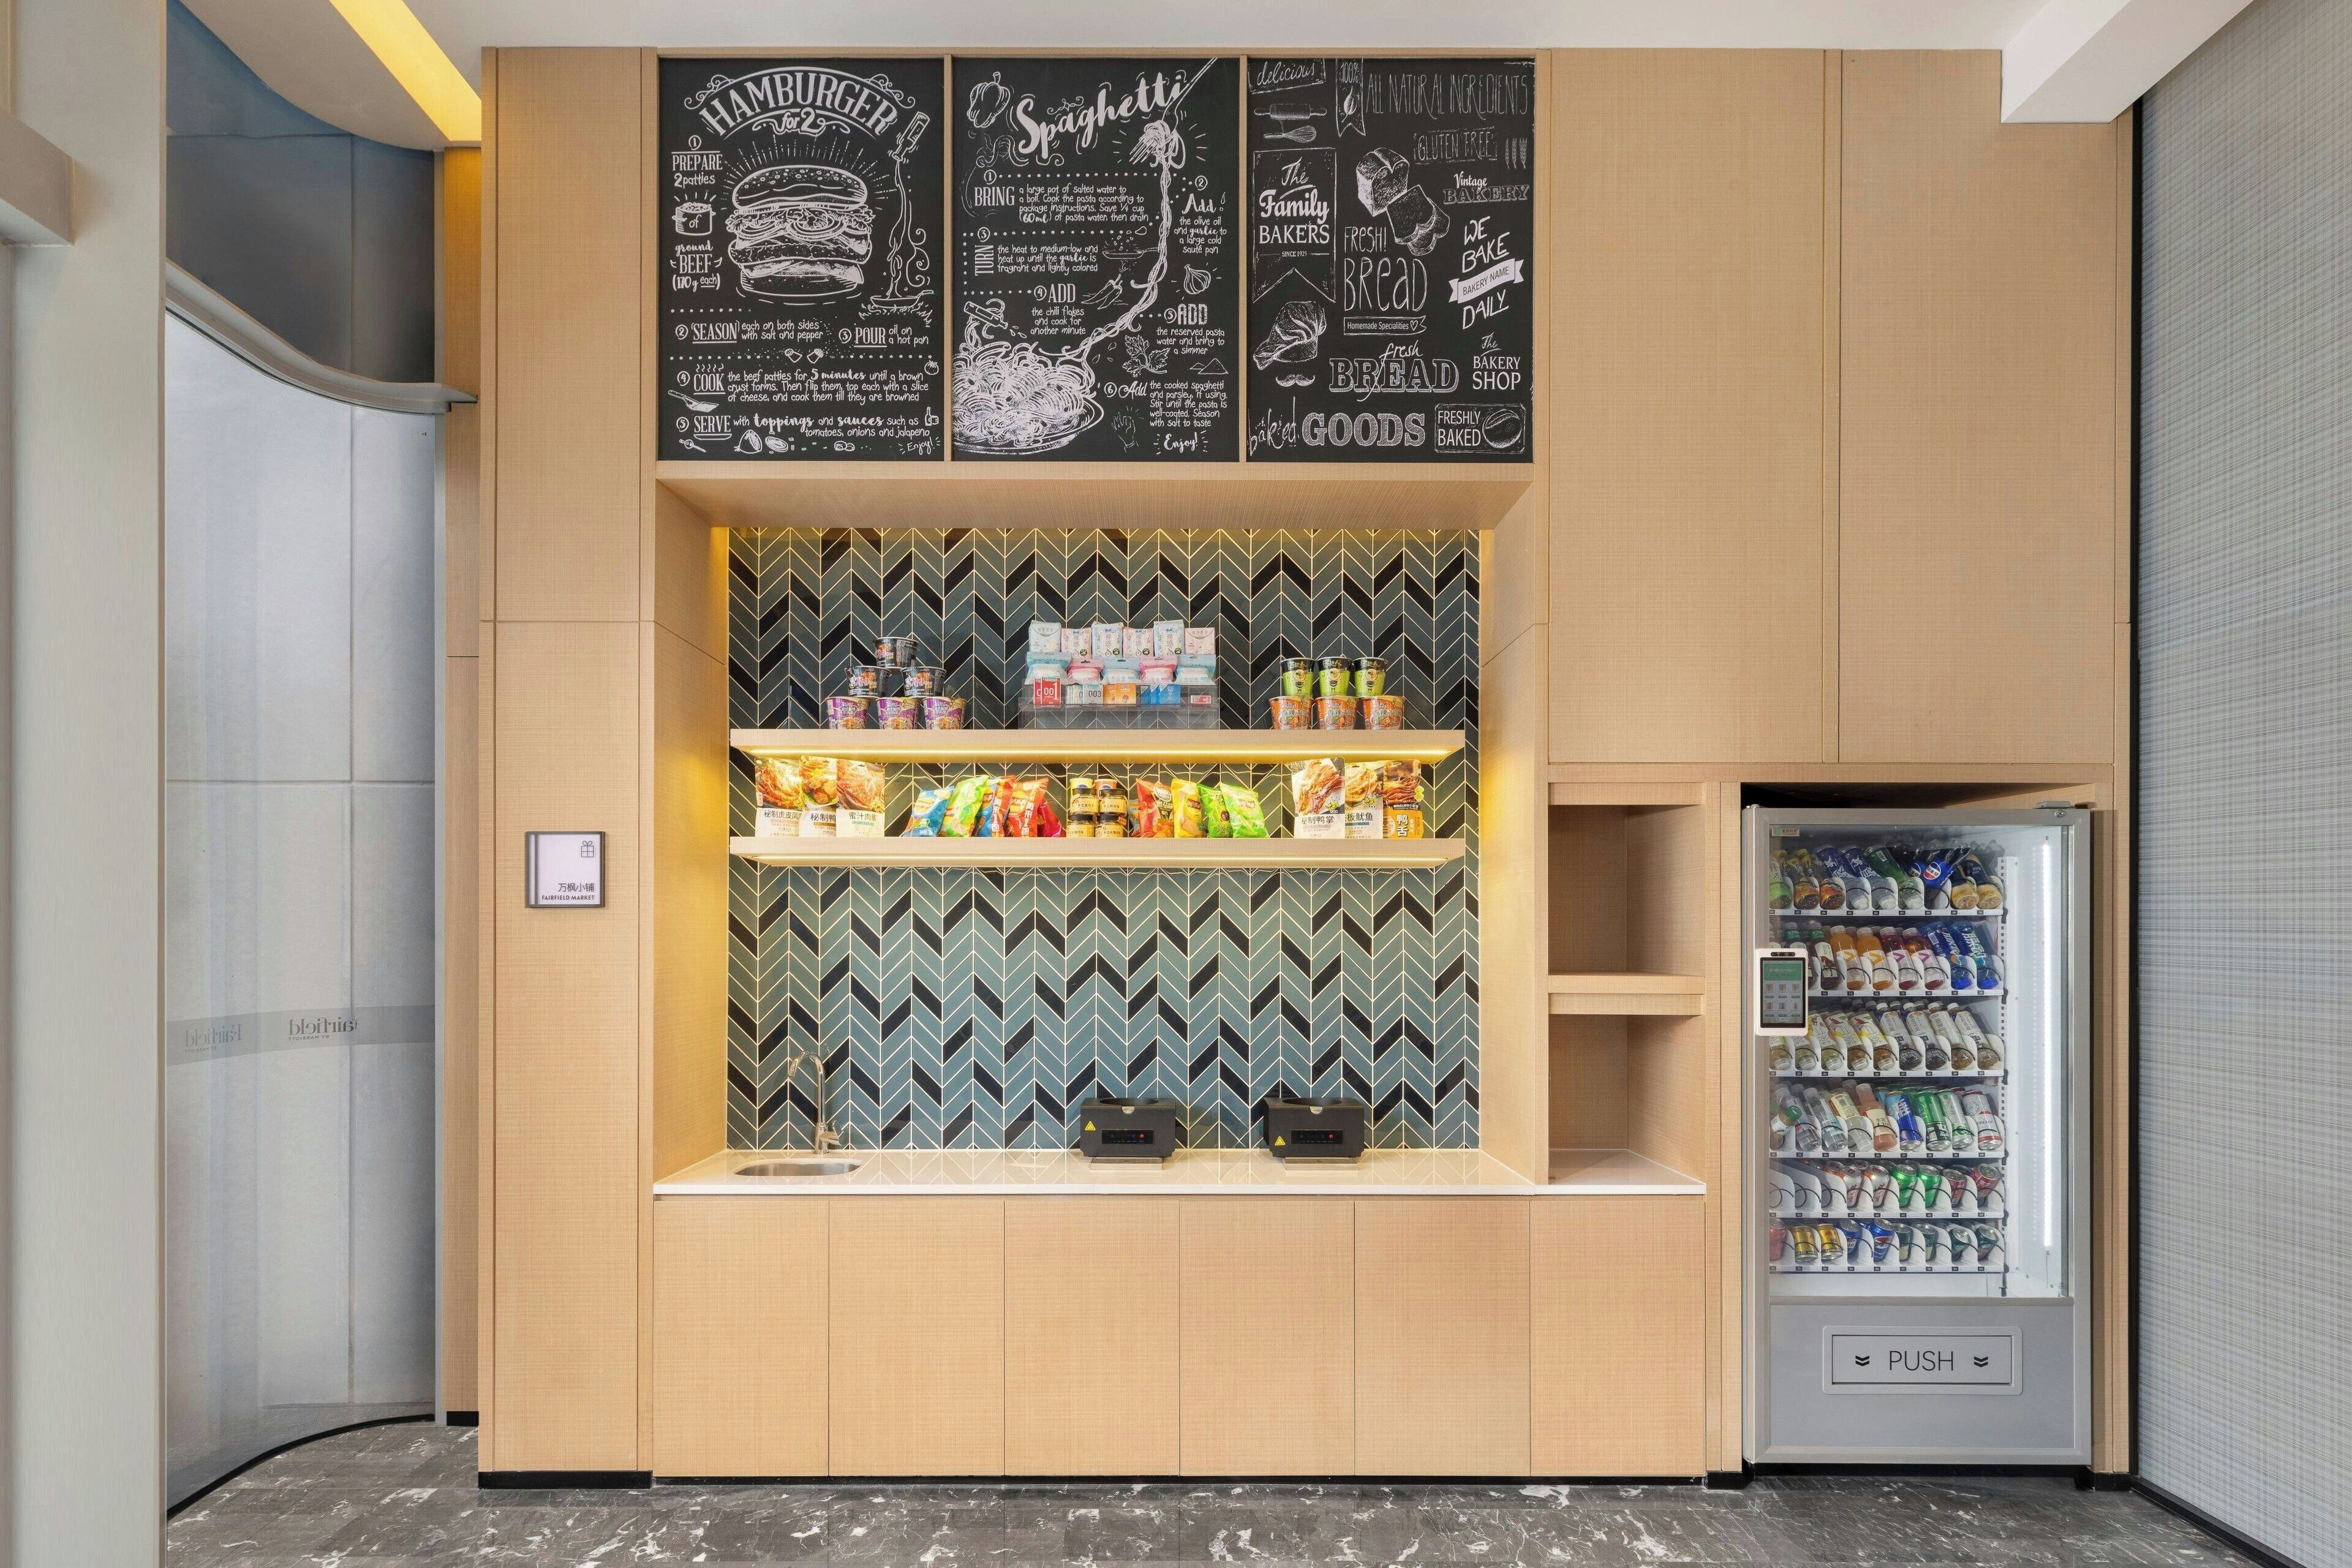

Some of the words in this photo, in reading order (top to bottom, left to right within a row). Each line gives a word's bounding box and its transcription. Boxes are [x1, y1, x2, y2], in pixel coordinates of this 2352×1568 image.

[1257, 61, 1314, 85] delicious
[1341, 62, 1358, 83] 100%
[699, 72, 897, 136] HAMBURGER
[1366, 74, 1384, 114] ALL
[1389, 74, 1444, 119] NATURAL
[1450, 74, 1528, 120] INGREDIENTS
[782, 113, 799, 129] for
[801, 108, 824, 131] 2
[1016, 72, 1182, 159] Spaghetti
[1418, 134, 1458, 160] GLUTEN
[1463, 131, 1492, 159] FREE
[673, 154, 723, 171] PREPARE
[1281, 157, 1309, 186] The
[674, 173, 682, 187] 2
[683, 174, 715, 189] patties
[1453, 171, 1487, 189] Vintage
[974, 186, 1015, 206] BRING
[1027, 184, 1046, 197] large
[1048, 185, 1059, 197] pot
[1062, 183, 1071, 193] of
[1073, 183, 1093, 193] salted
[1443, 184, 1530, 205] BAKERY
[1182, 193, 1216, 214] Add
[1259, 189, 1329, 225] Family
[689, 214, 701, 228] of
[1180, 216, 1191, 225] the
[1194, 216, 1210, 225] olive
[1187, 233, 1205, 246] large
[1208, 235, 1221, 244] cold
[1189, 225, 1218, 239] garlic
[1259, 225, 1330, 244] BAKERS
[1464, 216, 1490, 245] WE
[676, 240, 713, 258] ground
[997, 244, 1009, 255] the
[1012, 244, 1027, 253] heat
[1041, 243, 1082, 252] medium-low
[1205, 247, 1218, 256] pan
[1462, 232, 1510, 273] BAKE
[679, 253, 712, 273] BEEF
[974, 245, 994, 276] TURN
[673, 274, 692, 291] (170
[692, 279, 698, 292] g
[700, 273, 720, 290] each)
[1463, 277, 1488, 296] BAKERY
[1489, 266, 1510, 283] NAME
[1048, 284, 1076, 303] ADD
[1031, 307, 1042, 316] the
[1046, 306, 1060, 315] chili
[1062, 306, 1084, 317] flakes
[1178, 304, 1207, 325] ADD
[1463, 289, 1509, 330] DAILY
[742, 320, 760, 330] each
[777, 320, 794, 330] both
[797, 320, 819, 330] sides
[1051, 314, 1067, 325] cook
[1069, 313, 1083, 325] for
[1379, 322, 1409, 330] Specialities
[693, 323, 737, 340] SEASON
[742, 331, 758, 340] with
[761, 331, 776, 339] salt
[779, 331, 794, 339] and
[797, 331, 823, 342] pepper
[854, 328, 886, 344] POUR
[889, 324, 899, 336] oil
[1030, 326, 1058, 335] another
[1061, 325, 1085, 334] minute
[1156, 326, 1168, 335] the
[1205, 328, 1224, 340] pasta
[896, 333, 910, 344] hot
[914, 336, 929, 347] pan
[1481, 332, 1498, 349] The
[1357, 340, 1423, 402] fresh
[1473, 356, 1521, 369] BAKERY
[694, 374, 725, 391] COOK
[728, 371, 741, 381] the
[744, 369, 763, 382] beef
[764, 371, 791, 385] patties
[794, 369, 807, 380] for
[811, 368, 818, 380] 5
[821, 369, 866, 380] minutes
[870, 370, 887, 380] until
[899, 370, 923, 380] brown
[1329, 358, 1459, 393] BREAD
[1472, 371, 1521, 390] SHOP
[1118, 381, 1147, 399] Add
[1150, 380, 1161, 389] the
[1164, 380, 1188, 389] cooked
[1191, 380, 1224, 393] spaghetti
[694, 415, 731, 432] SERVE
[733, 415, 750, 426] with
[753, 413, 815, 434] toppings
[818, 417, 833, 426] and
[837, 417, 884, 426] sauces
[887, 415, 905, 425] such
[1150, 418, 1164, 427] with
[1167, 417, 1180, 427] salt
[1183, 418, 1190, 427] to
[1193, 418, 1211, 427] taste
[1438, 411, 1481, 424] FRESHLY
[847, 426, 875, 437] onions
[879, 428, 894, 437] and
[895, 426, 930, 440] jalapeno
[1302, 413, 1425, 447] GOODS
[1438, 429, 1481, 447] BAKED
[907, 437, 935, 455] Enjoy!
[1164, 432, 1198, 453] Enjoy!
[1345, 812, 1373, 821] 板鱿鱼
[1396, 814, 1408, 837] 鸭舌
[558, 883, 594, 892] 万枫小铺
[1889, 1351, 1954, 1371] PUSH
